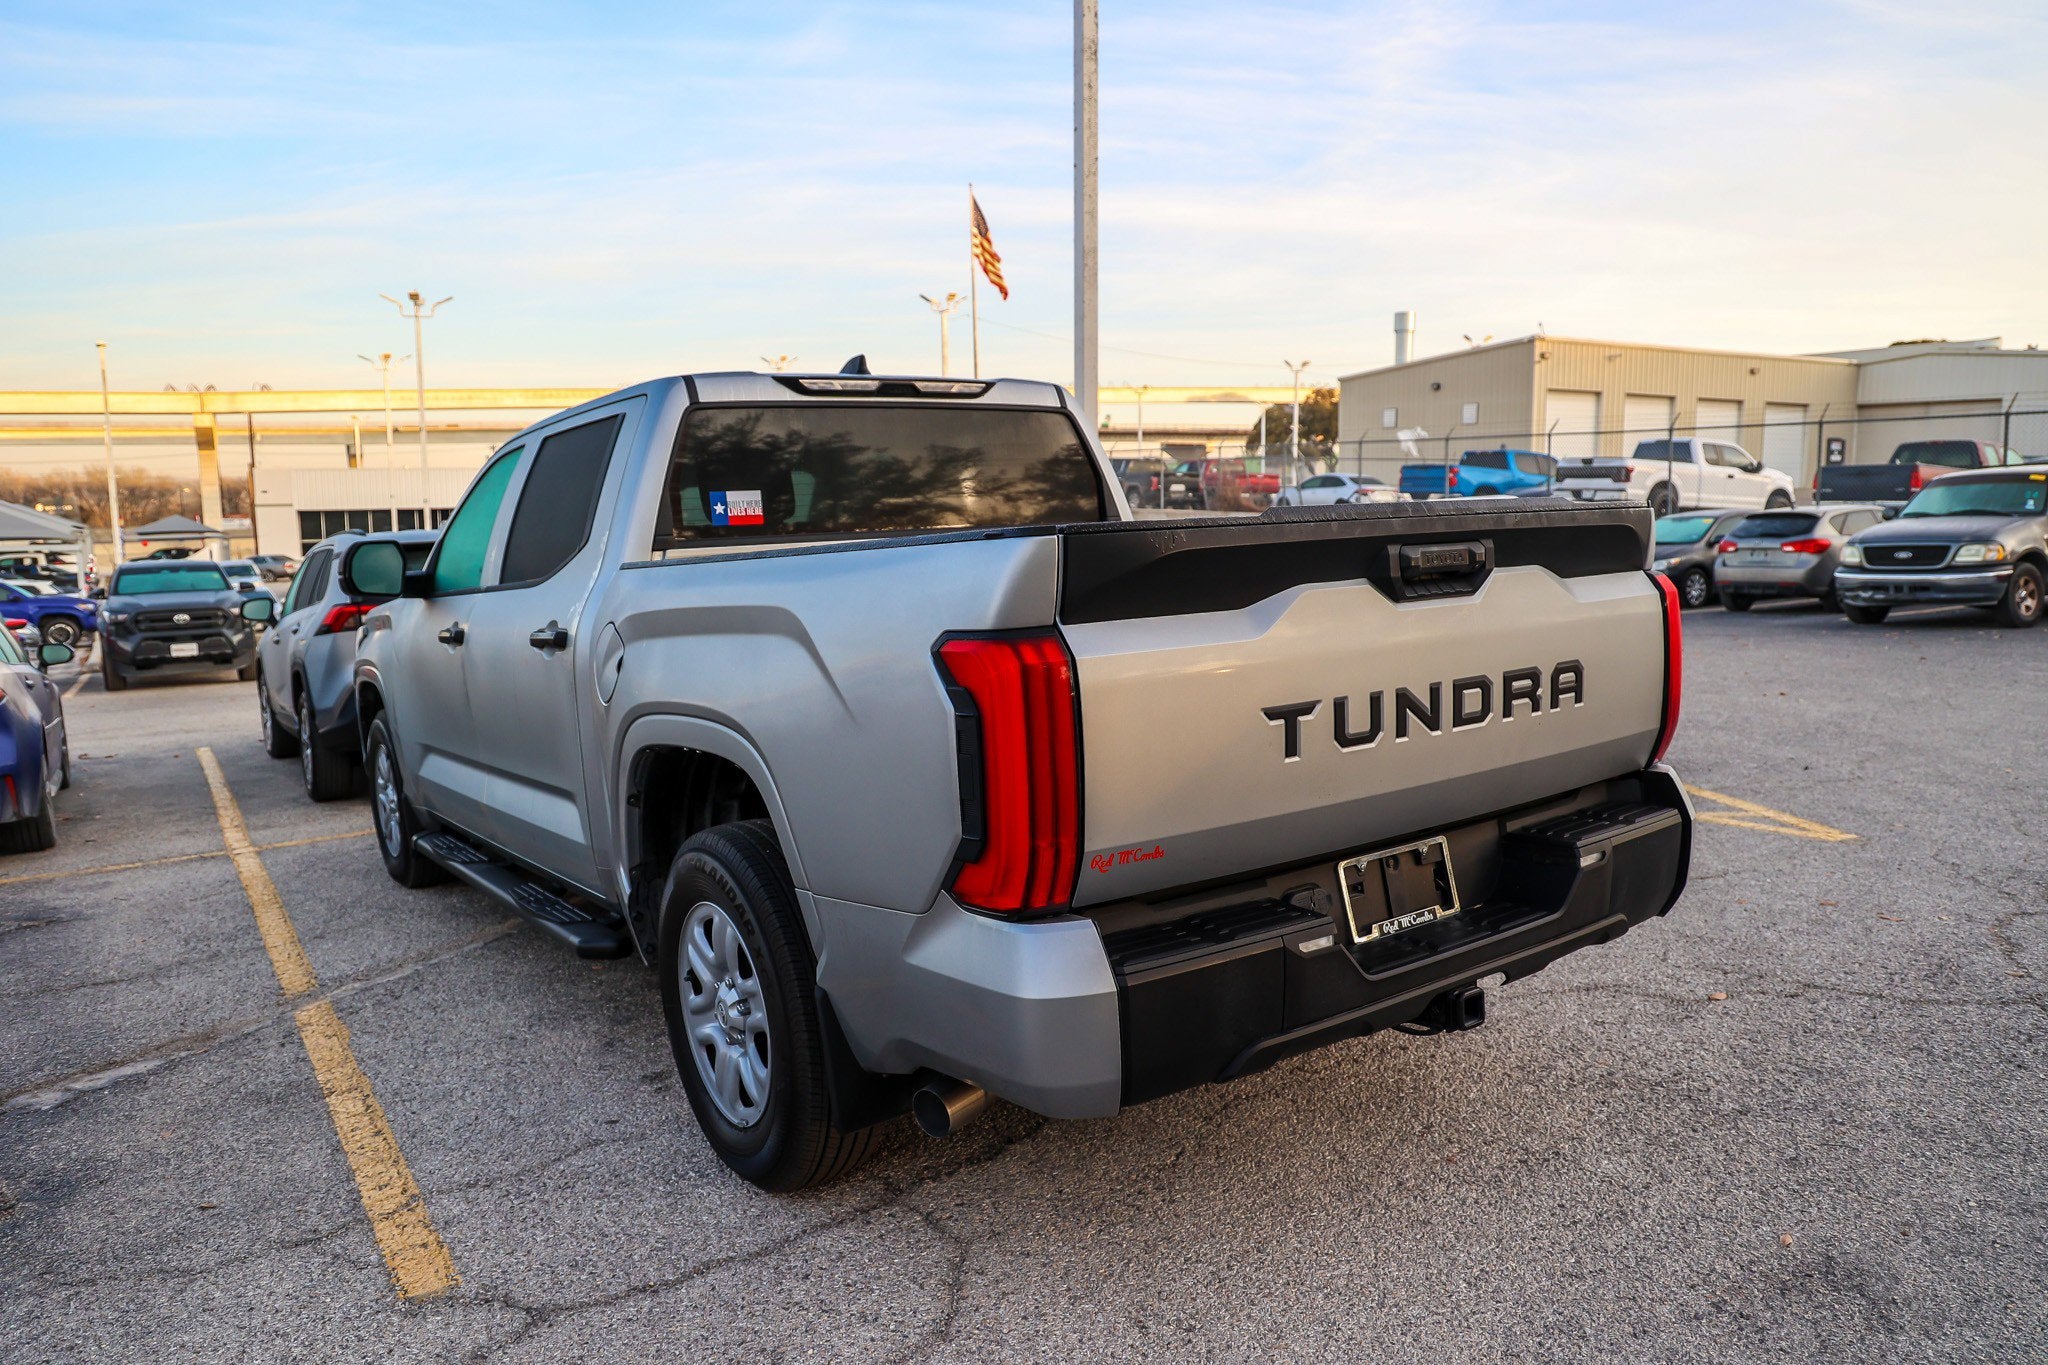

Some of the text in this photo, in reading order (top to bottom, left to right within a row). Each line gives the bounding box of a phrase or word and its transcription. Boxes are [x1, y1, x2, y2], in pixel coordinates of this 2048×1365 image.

[727, 507, 763, 516] LIVES HERE
[1425, 551, 1465, 565] TOYOTA
[1260, 659, 1584, 763] TUNDRA
[1090, 853, 1115, 874] Red
[1383, 920, 1399, 934] Red
